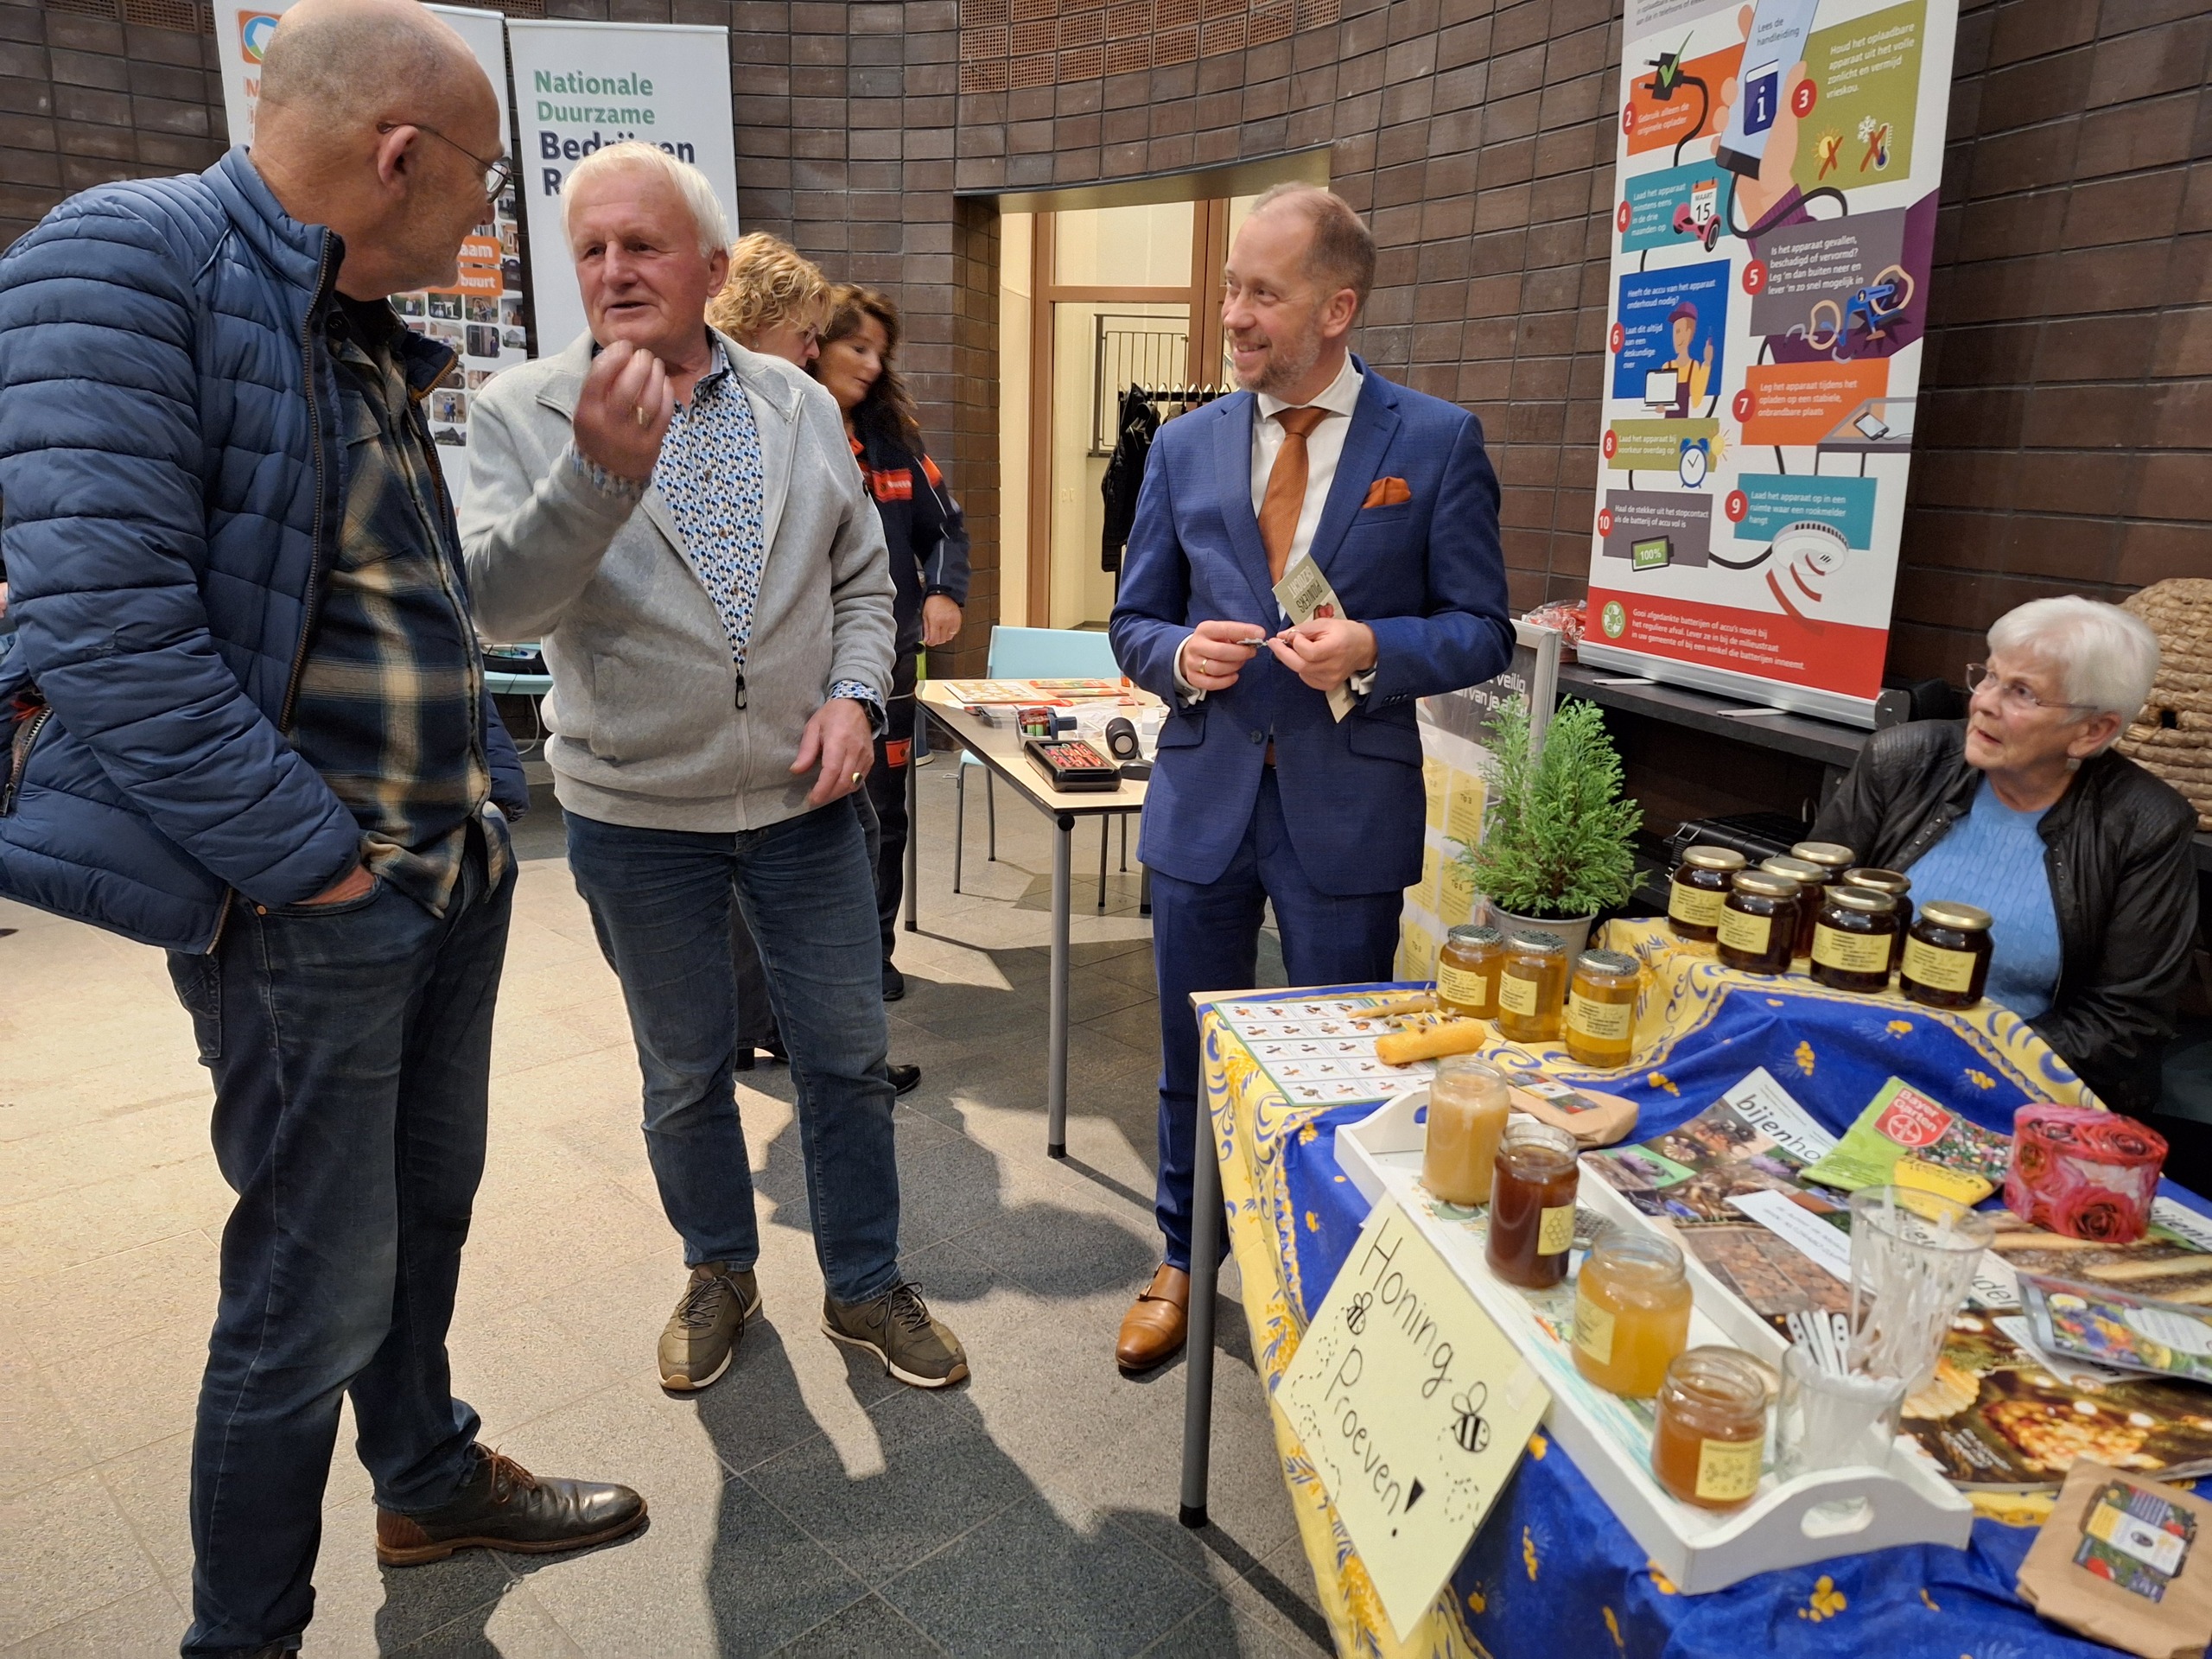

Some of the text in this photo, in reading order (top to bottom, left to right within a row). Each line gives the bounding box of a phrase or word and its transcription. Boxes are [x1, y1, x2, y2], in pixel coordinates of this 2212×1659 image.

[1758, 18, 1783, 33] Lees de
[1758, 28, 1799, 46] handleiding
[1830, 23, 1915, 54] Houd het oplaadbare
[1829, 38, 1914, 70] apparaat uit het volle
[1827, 55, 1902, 85] zonlicht en vermijd
[533, 69, 653, 97] Nationale
[1799, 89, 1808, 108] 3
[1827, 85, 1859, 99] vrieskou.
[536, 100, 655, 125] Duurzame
[1625, 111, 1631, 127] 2
[1658, 183, 1686, 195] apparaat
[1695, 192, 1713, 200] MAART
[1620, 209, 1626, 224] 4
[1696, 203, 1710, 221] 15
[1631, 226, 1656, 236] maanden
[460, 245, 493, 257] aam
[1778, 245, 1790, 254] het
[1791, 240, 1822, 254] apparaat
[1824, 235, 1857, 249] gevallen,
[1770, 248, 1859, 269] beschadigd of vervormd?
[1749, 269, 1758, 286] 5
[1770, 273, 1782, 283] Leg
[1793, 270, 1806, 278] dan
[1808, 266, 1831, 276] buiten
[1834, 264, 1850, 273] neer
[1628, 289, 1642, 297] Heeft
[1689, 280, 1715, 291] apparaat
[1768, 286, 1784, 295] lever
[1806, 280, 1821, 290] snel
[1822, 276, 1853, 289] mogelijk
[1627, 296, 1679, 309] onderhoud nodig?
[1625, 326, 1637, 334] Laat
[1647, 323, 1662, 334] altijd
[1613, 330, 1618, 345] 6
[1624, 348, 1656, 358] deskundige
[1760, 384, 1772, 392] Leg
[1786, 382, 1817, 391] apparaat
[1820, 380, 1842, 391] tijdens
[1739, 398, 1749, 414] 7
[1759, 395, 1785, 404] opladen
[1788, 396, 1796, 404] op
[1758, 407, 1824, 416] onbrandbare plaats
[1606, 437, 1612, 451] 8
[1643, 447, 1666, 455] overdag
[1751, 491, 1766, 499] Laad
[1813, 495, 1821, 504] op
[1636, 505, 1656, 514] stekker
[1675, 509, 1708, 518] stopcontact
[1732, 498, 1740, 514] 9
[1806, 507, 1846, 517] rookmelder
[1599, 516, 1609, 530] 10
[1630, 517, 1650, 526] batterij
[1749, 515, 1768, 525] hangt
[1640, 548, 1662, 560] 100%
[1287, 566, 1314, 599] GEZOCHT
[1296, 580, 1323, 613] PIONIERS
[1647, 611, 1680, 622] afgedankte
[1681, 616, 1710, 628] batterijen
[1739, 627, 1757, 636] nooit
[1758, 628, 1767, 639] bij
[1643, 622, 1668, 632] reguliere
[1719, 634, 1728, 645] bij
[1738, 639, 1779, 652] milieustraat
[1649, 635, 1676, 645] gemeente
[1707, 643, 1728, 655] winkel
[1729, 648, 1739, 657] die
[1740, 650, 1773, 664] batterijen
[1497, 673, 1525, 697] veilig
[1486, 691, 1499, 711] je
[1900, 1090, 1939, 1117] Bayer
[1893, 1098, 1937, 1132] Garten
[1736, 1094, 1821, 1159] bijenho
[1359, 1217, 1454, 1399] Honing
[1325, 1344, 1425, 1538] Proeven!
